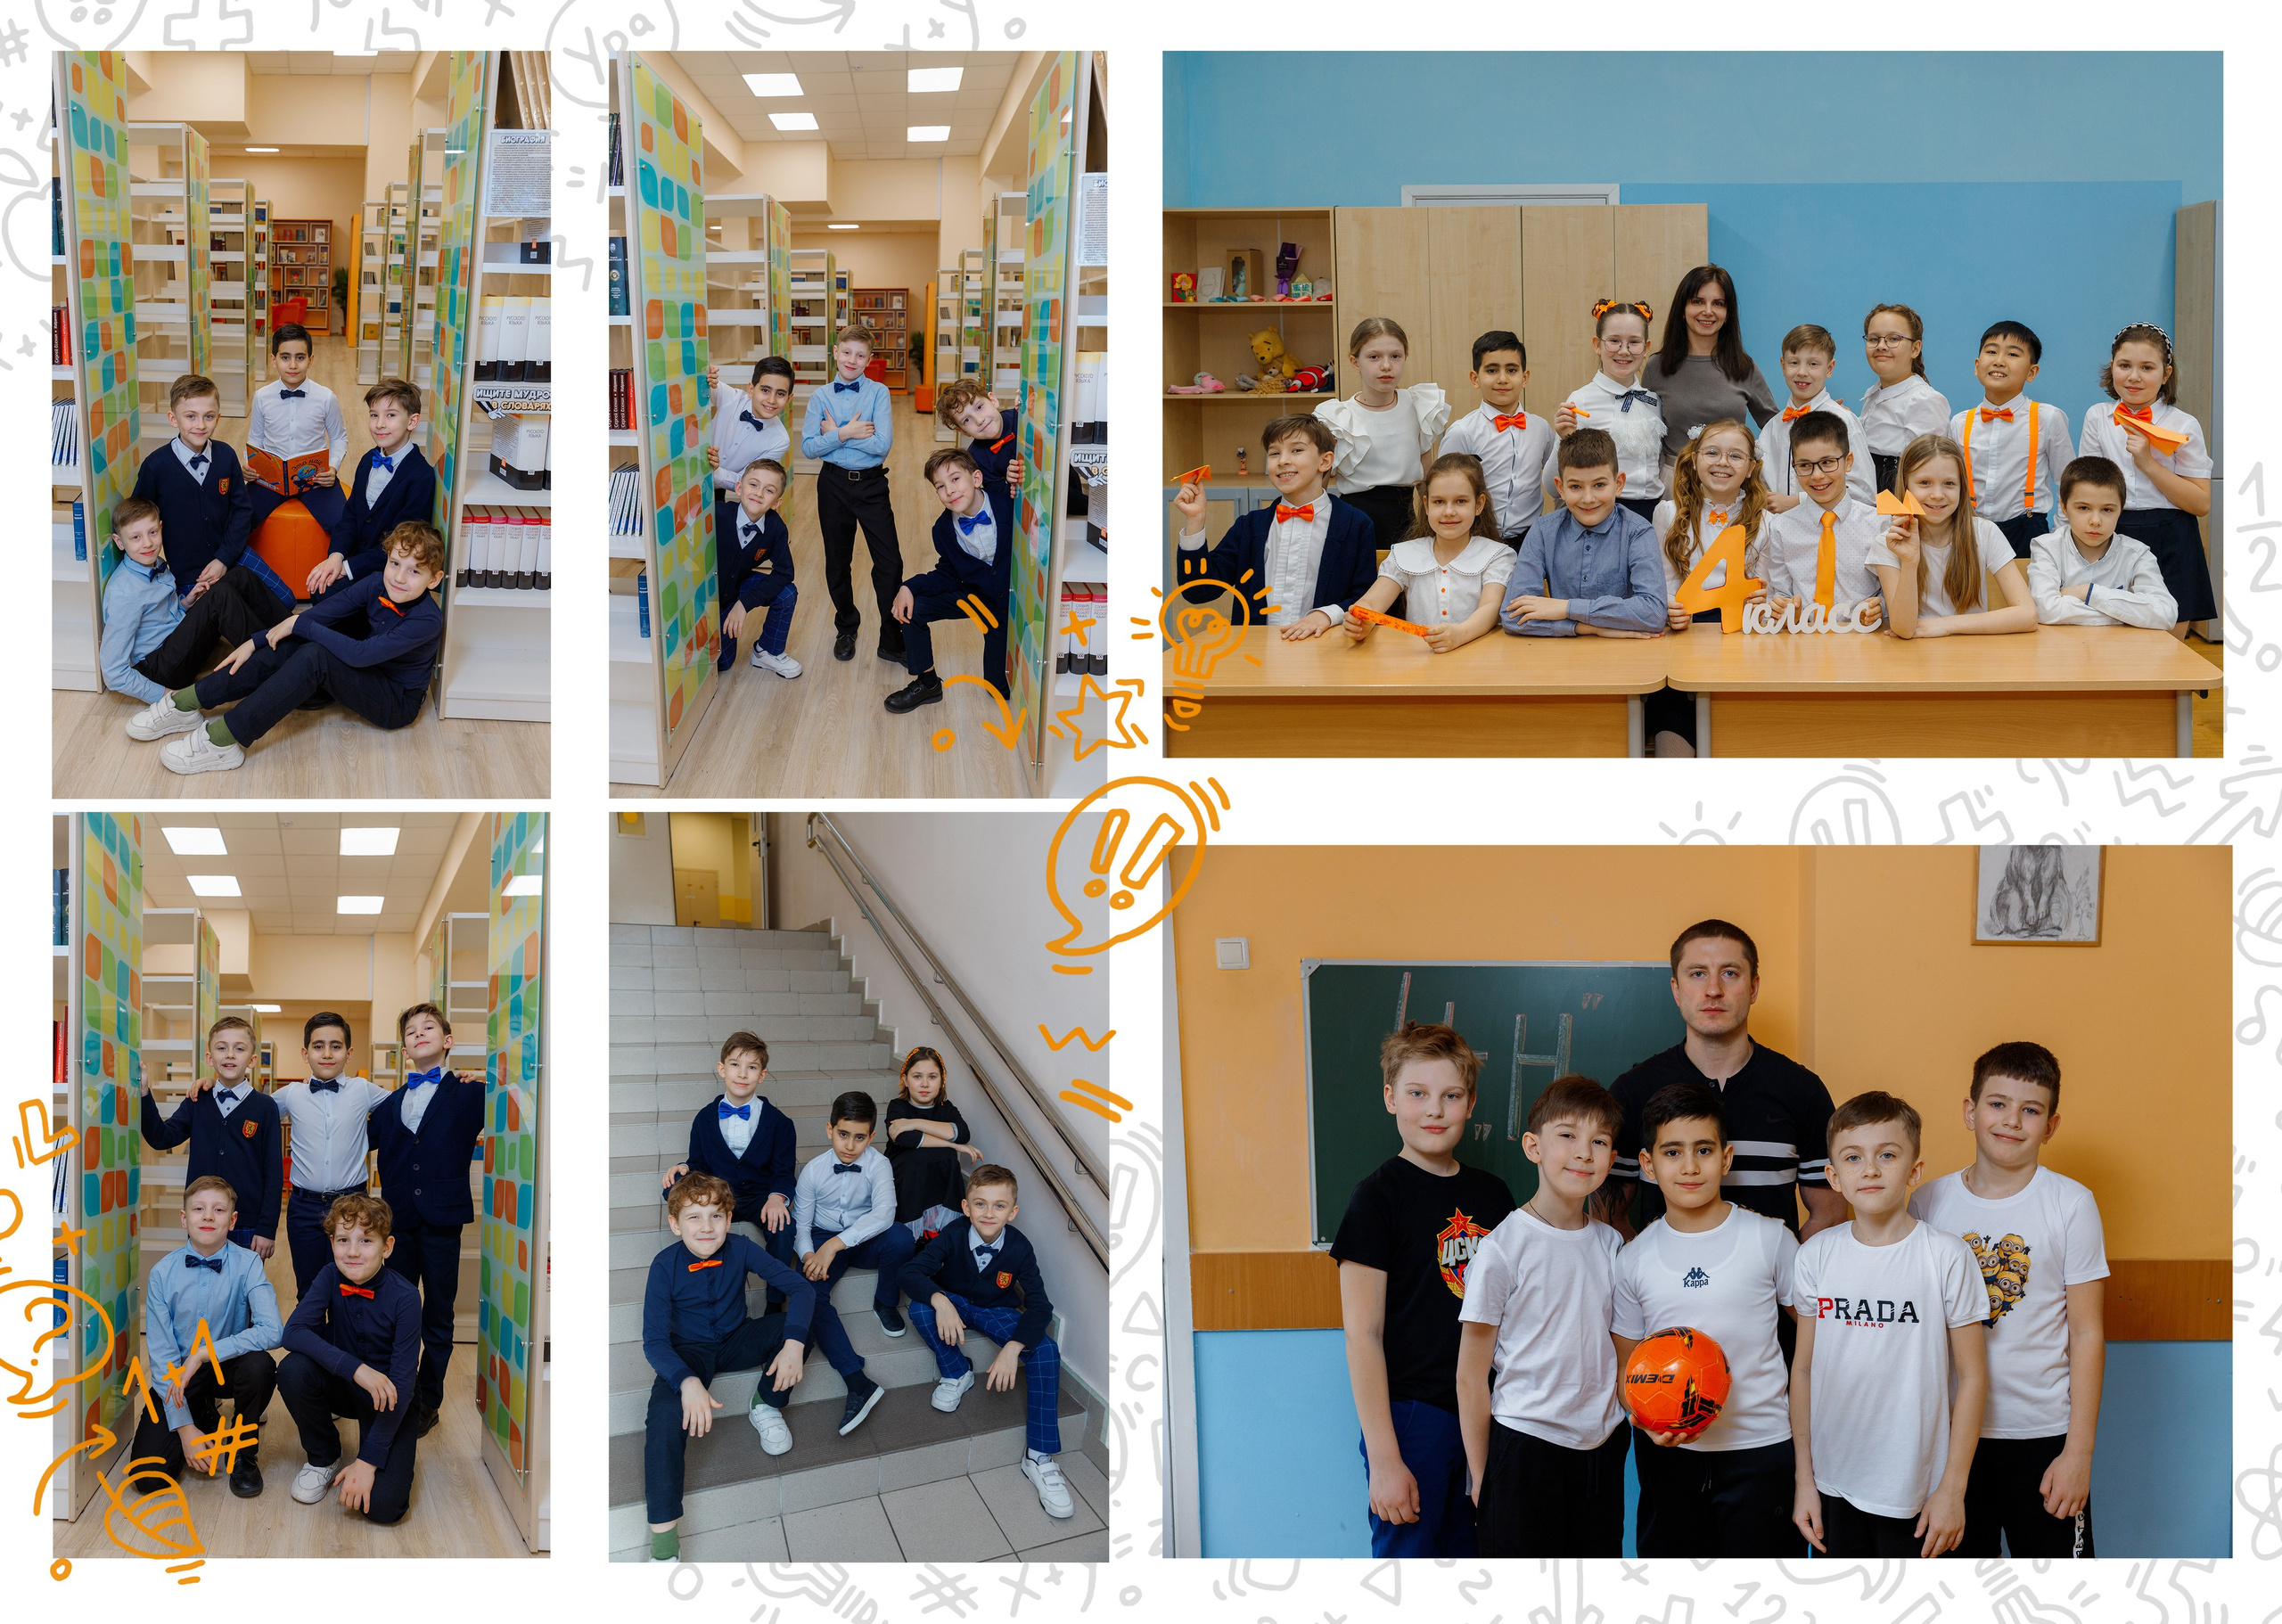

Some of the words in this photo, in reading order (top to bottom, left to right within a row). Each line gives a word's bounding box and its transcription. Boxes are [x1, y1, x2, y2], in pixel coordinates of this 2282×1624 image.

[501, 135, 546, 144] БИОГРАФИЯ
[476, 389, 512, 400] ИЩИТЕ
[513, 390, 551, 400] МУДРО
[491, 400, 497, 409] В
[500, 401, 551, 411] СЛОВАРЯХ
[1073, 452, 1107, 463] ИЩИТ
[1675, 523, 1762, 634] 4
[1742, 603, 1882, 635] класс
[1441, 1235, 1482, 1267] ЦСК
[1683, 1277, 1709, 1289] Kappa
[1818, 1297, 1919, 1324] PRADA
[1845, 1320, 1884, 1329] MILANO
